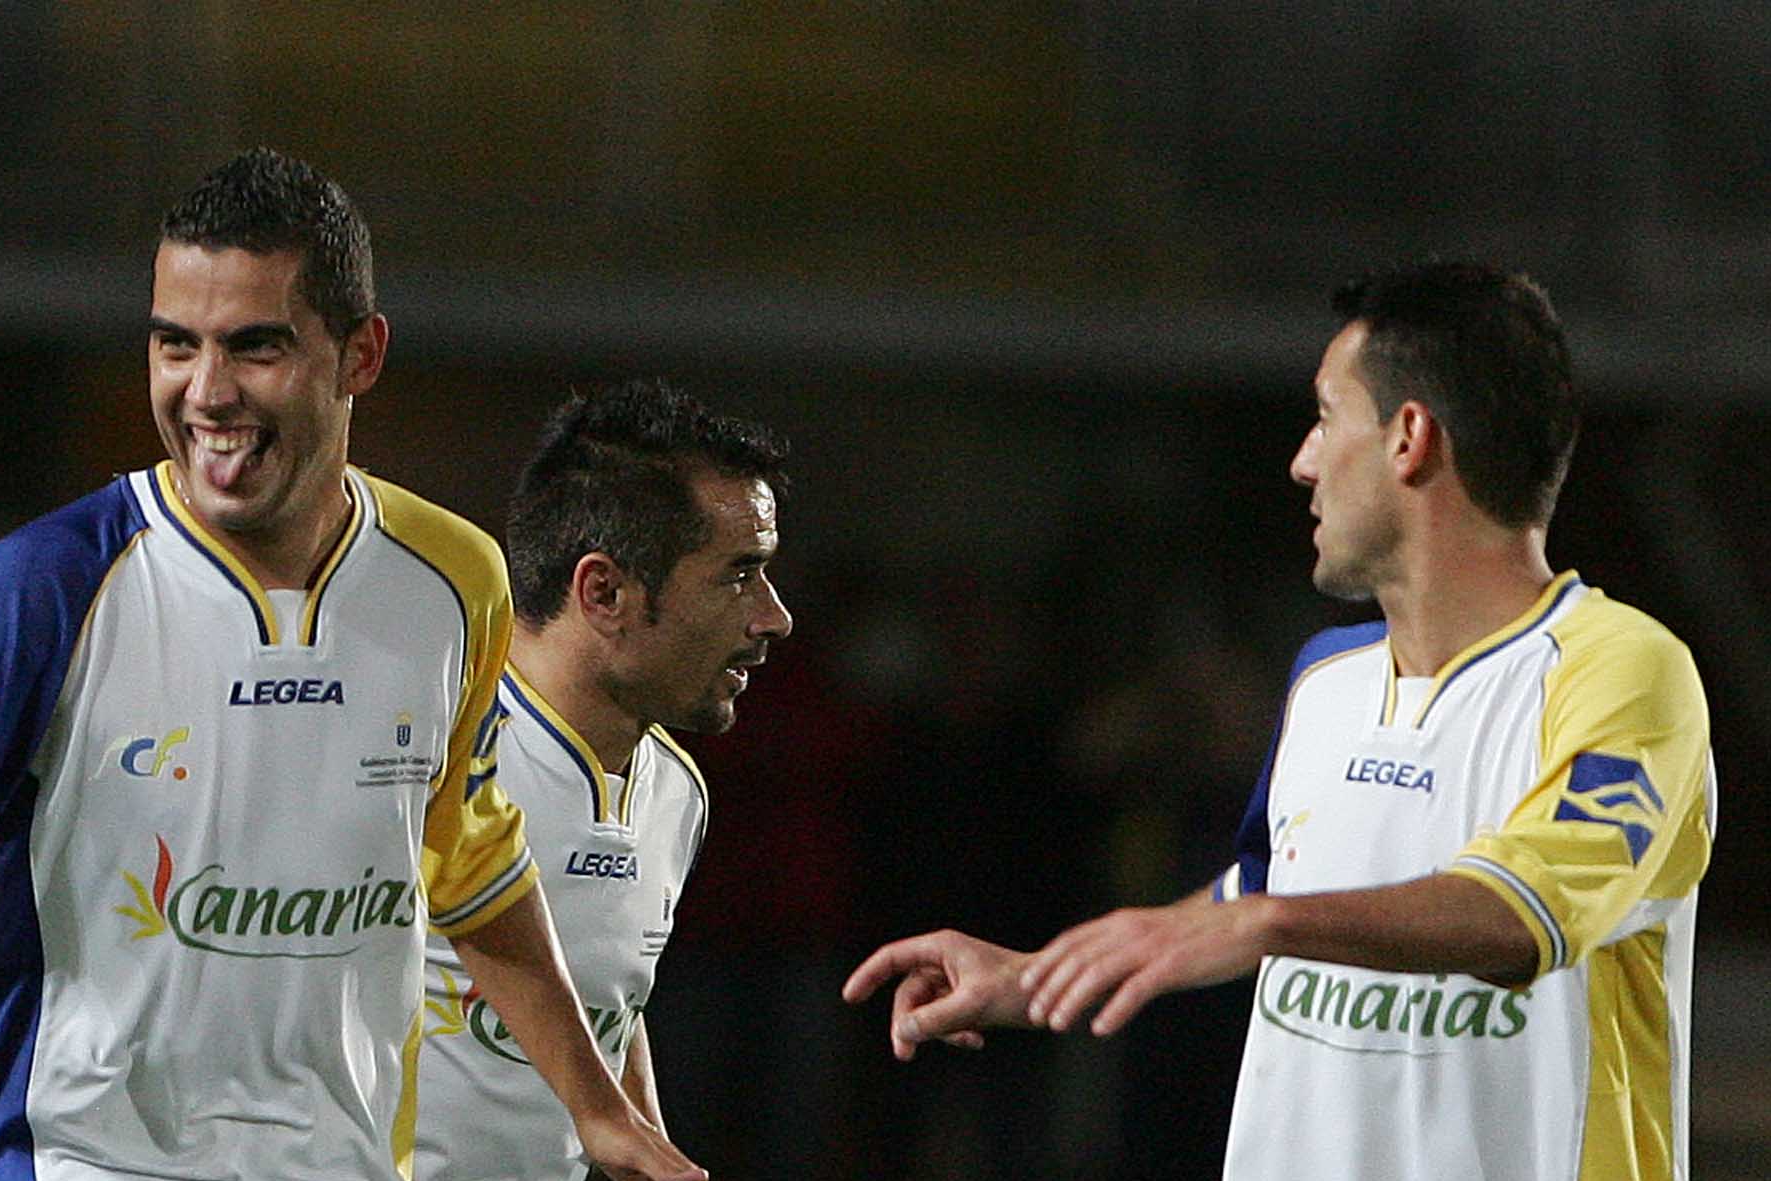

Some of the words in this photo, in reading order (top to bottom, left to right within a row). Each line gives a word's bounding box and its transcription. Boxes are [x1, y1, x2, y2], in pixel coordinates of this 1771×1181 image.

[229, 680, 345, 706] LEGEA
[1345, 758, 1436, 793] LEGEA
[565, 851, 638, 881] LEGEA
[167, 863, 415, 960] Canarias
